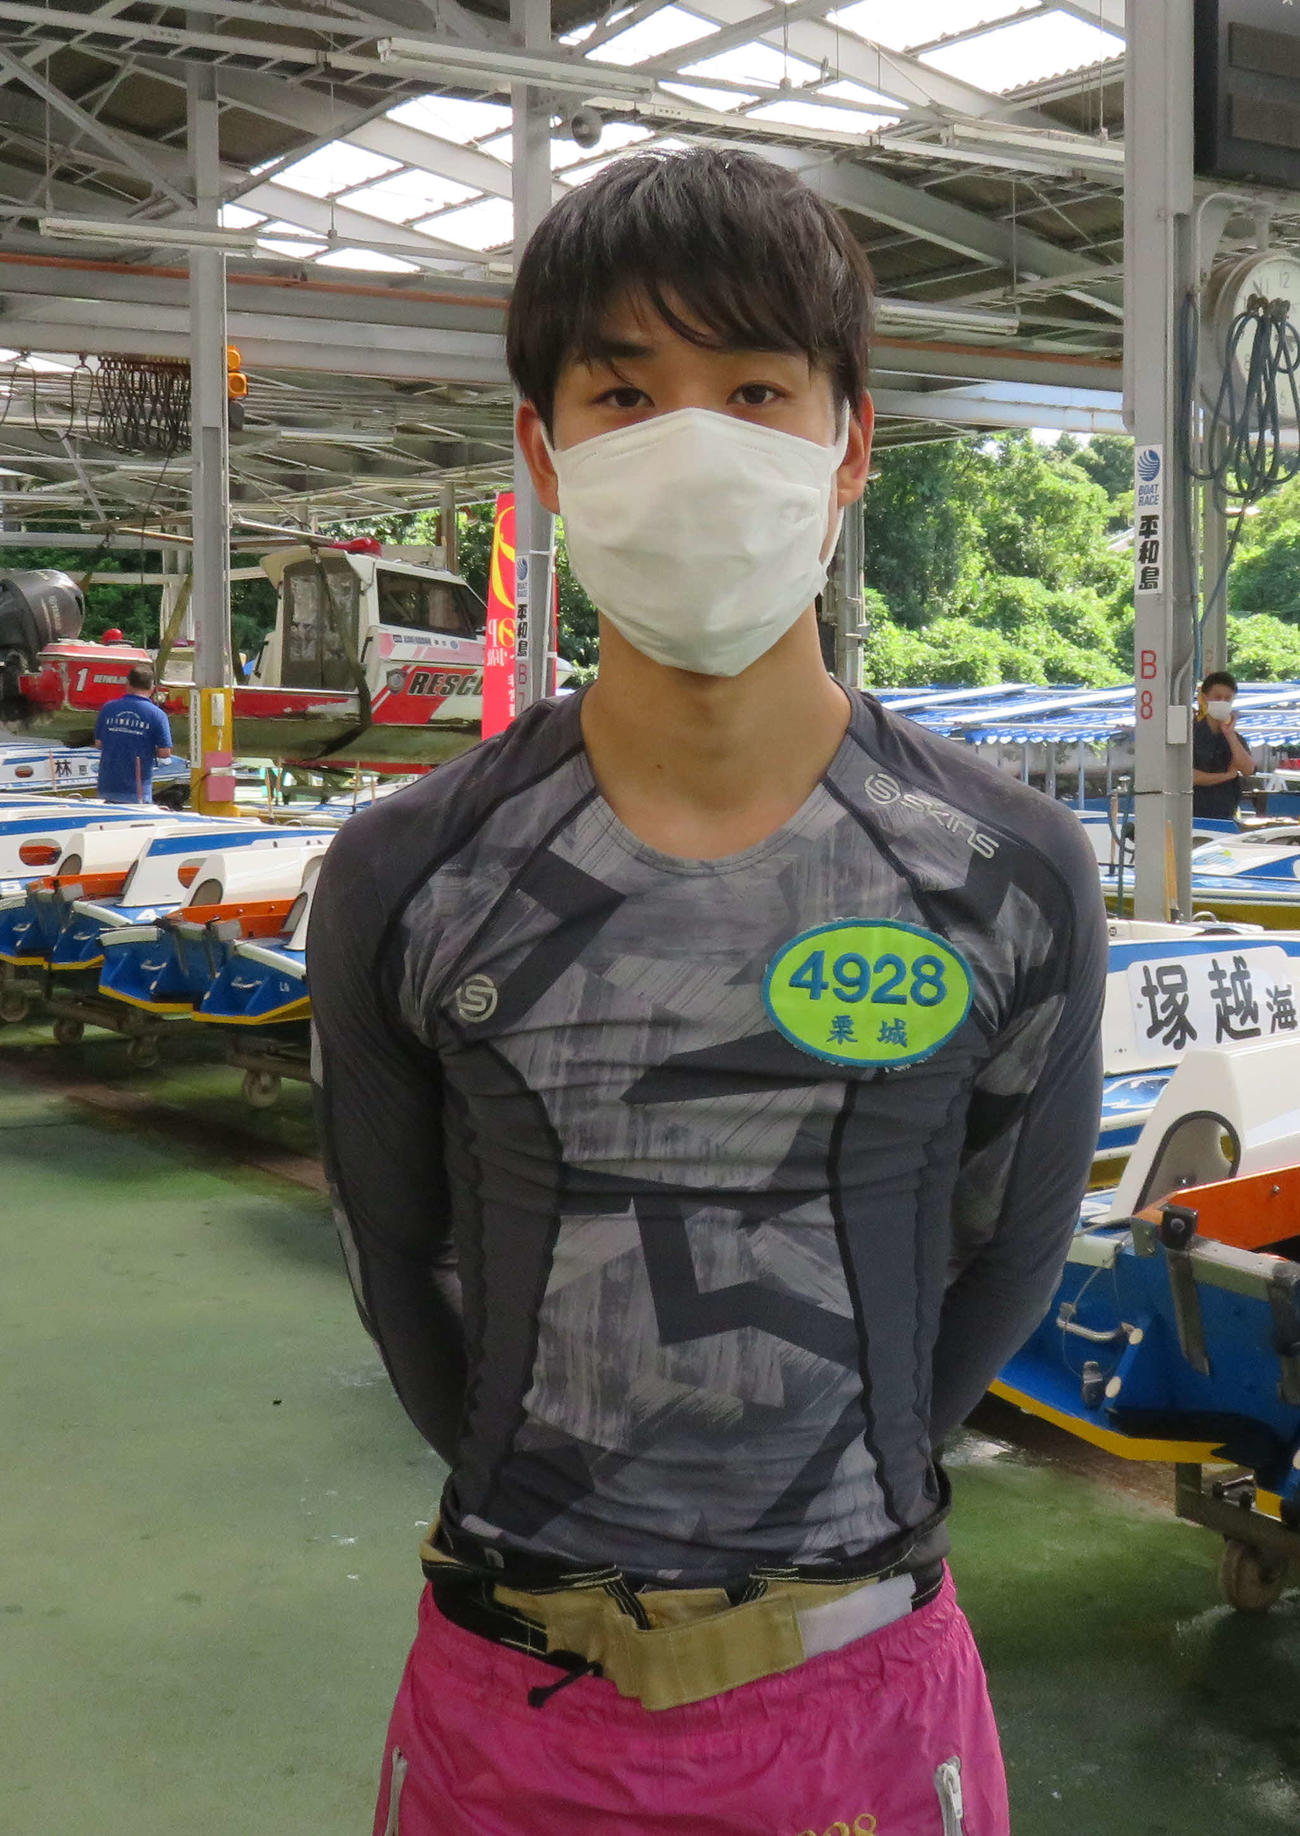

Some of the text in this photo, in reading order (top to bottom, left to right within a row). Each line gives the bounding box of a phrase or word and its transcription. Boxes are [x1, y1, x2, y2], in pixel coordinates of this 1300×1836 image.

[1138, 484, 1159, 495] BOAT
[1138, 495, 1160, 506] RACE
[1138, 514, 1160, 590] 平和島
[517, 603, 528, 657] 平和島
[76, 668, 88, 691] 1
[900, 793, 999, 859] SKINS
[789, 950, 946, 1007] 4928
[825, 1014, 908, 1048] 栗城
